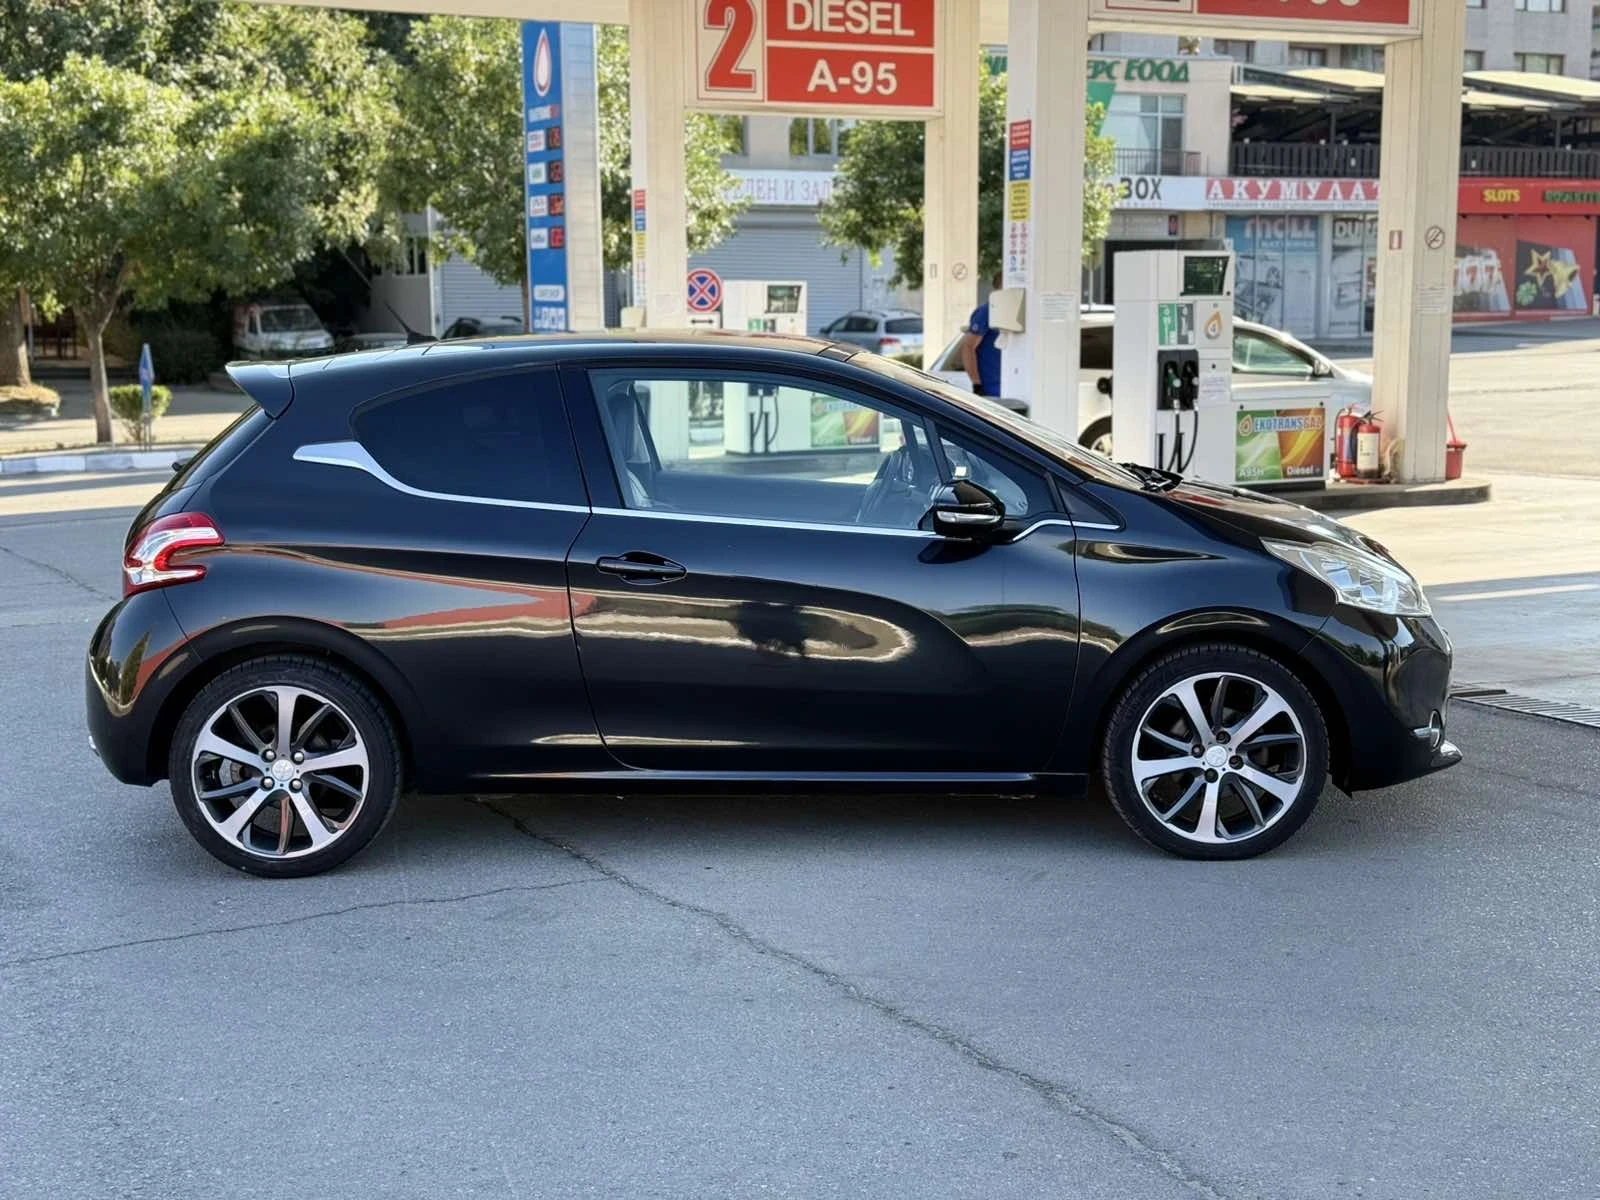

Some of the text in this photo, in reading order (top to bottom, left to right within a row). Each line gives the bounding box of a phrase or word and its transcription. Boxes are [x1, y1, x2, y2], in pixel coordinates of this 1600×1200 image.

[786, 0, 915, 36] DIESEL
[704, 0, 757, 92] 2
[807, 58, 898, 96] A-95
[1483, 188, 1521, 203] SLOTS
